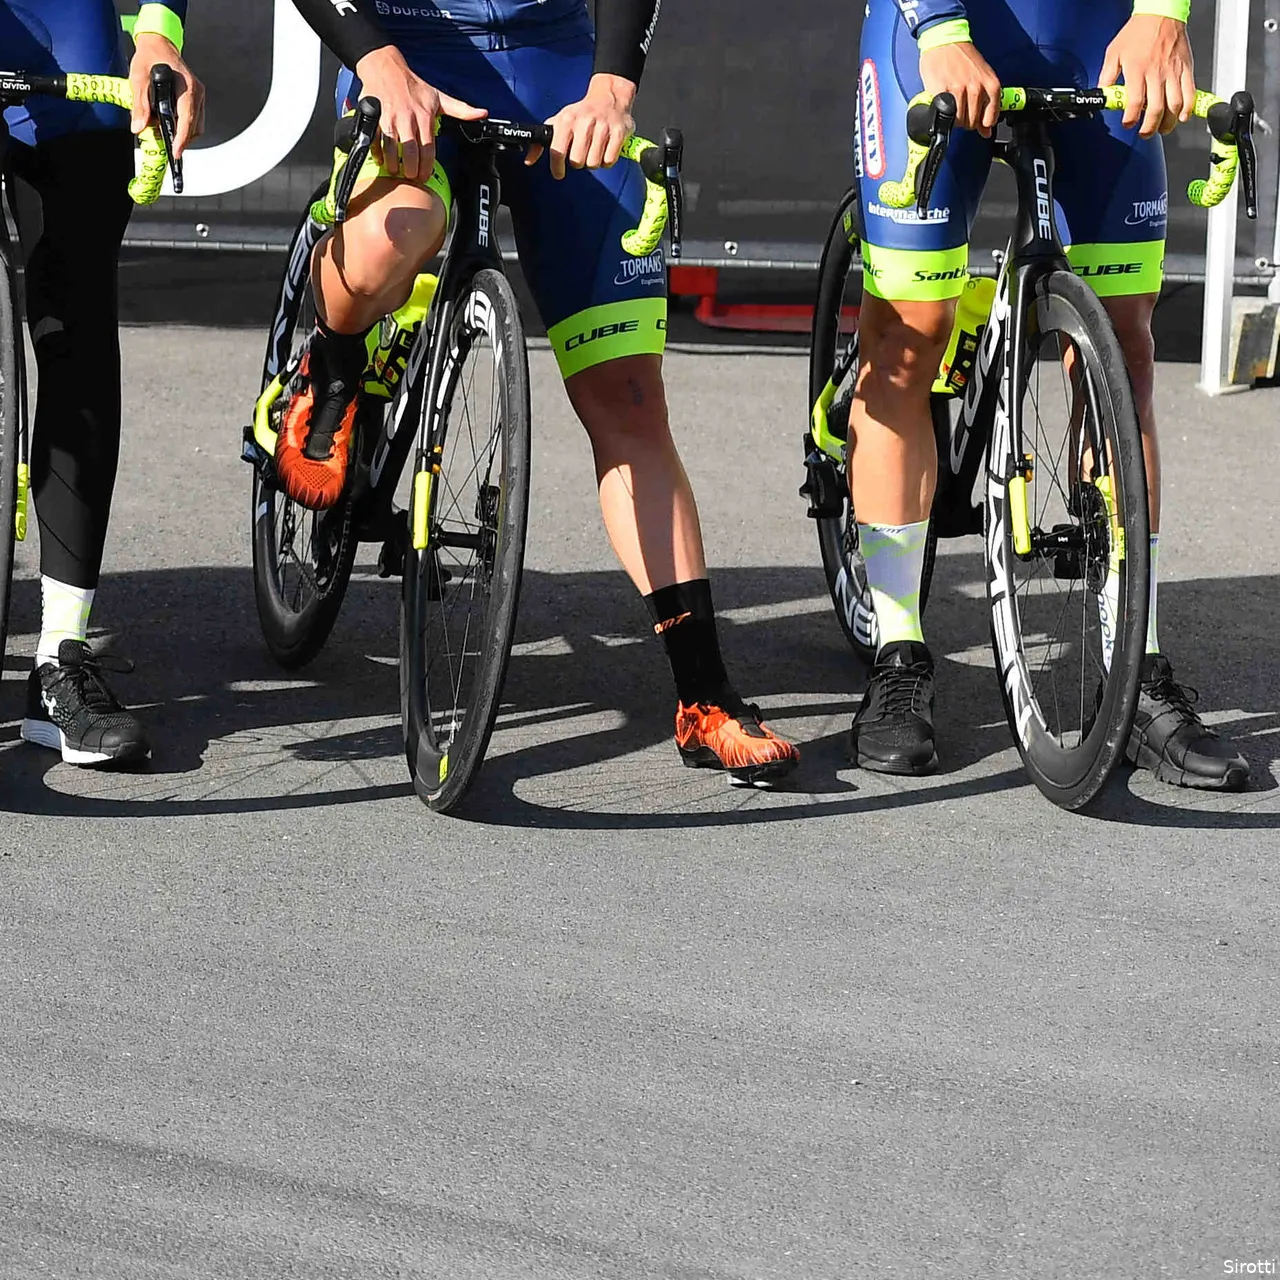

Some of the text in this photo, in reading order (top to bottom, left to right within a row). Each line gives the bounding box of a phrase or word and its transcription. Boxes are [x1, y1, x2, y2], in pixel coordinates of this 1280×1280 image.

[391, 5, 453, 19] DUFOUR
[2, 81, 31, 92] bryton
[1076, 95, 1104, 105] bryton
[864, 72, 880, 169] WANTY
[503, 128, 532, 138] bryton
[1033, 158, 1051, 240] CUBE
[478, 184, 489, 248] CUBE
[868, 201, 951, 223] Intermaché
[620, 256, 663, 276] TORMANS
[1072, 262, 1143, 278] CUBE
[565, 319, 640, 350] CUBE
